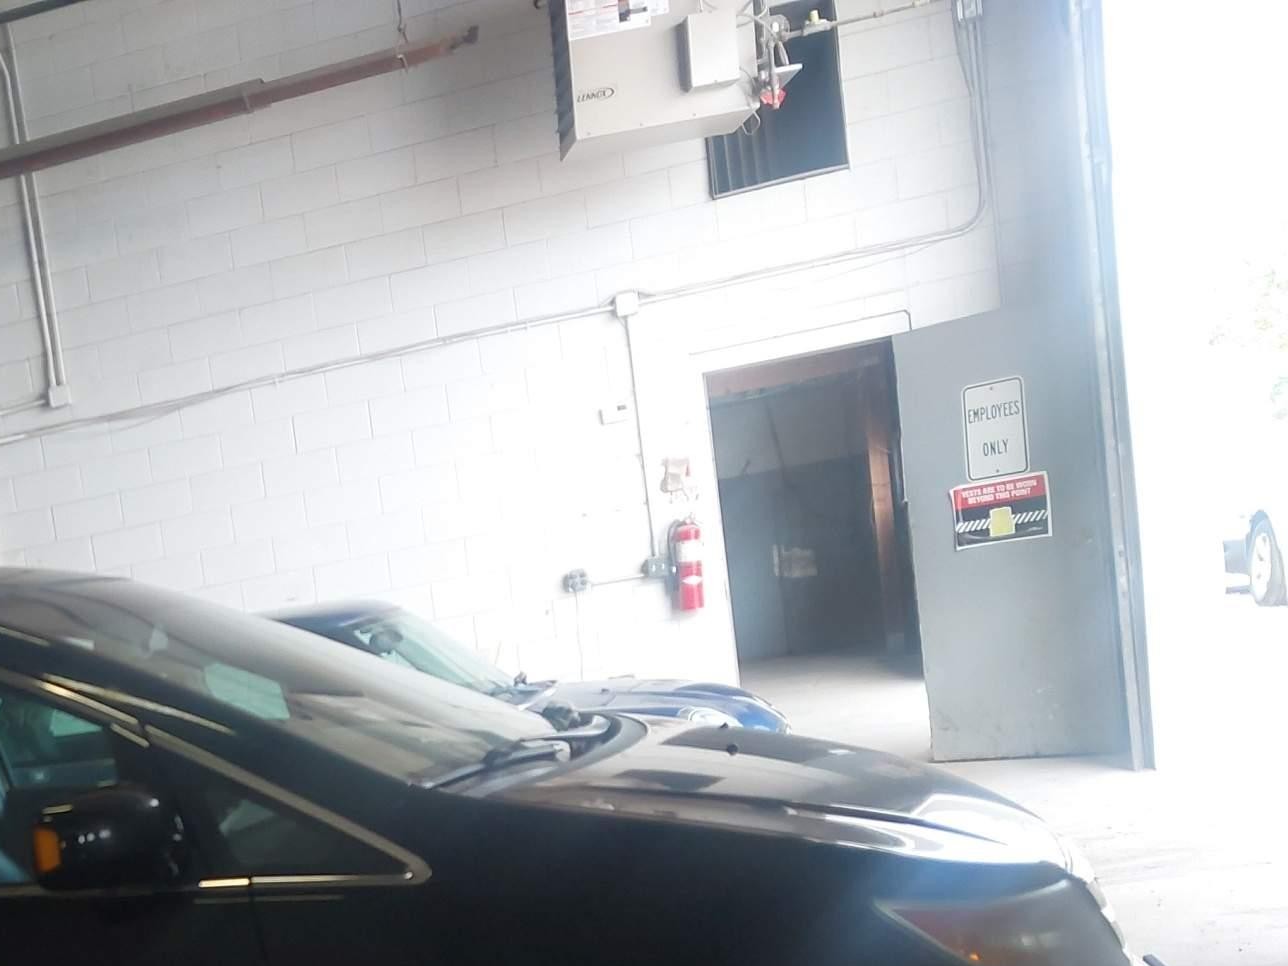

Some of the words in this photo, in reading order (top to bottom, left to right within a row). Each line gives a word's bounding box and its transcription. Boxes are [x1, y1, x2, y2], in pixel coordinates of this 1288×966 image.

[968, 400, 1020, 424] EMPLOYEES
[983, 438, 1009, 457] ONLY
[996, 484, 1005, 492] TO
